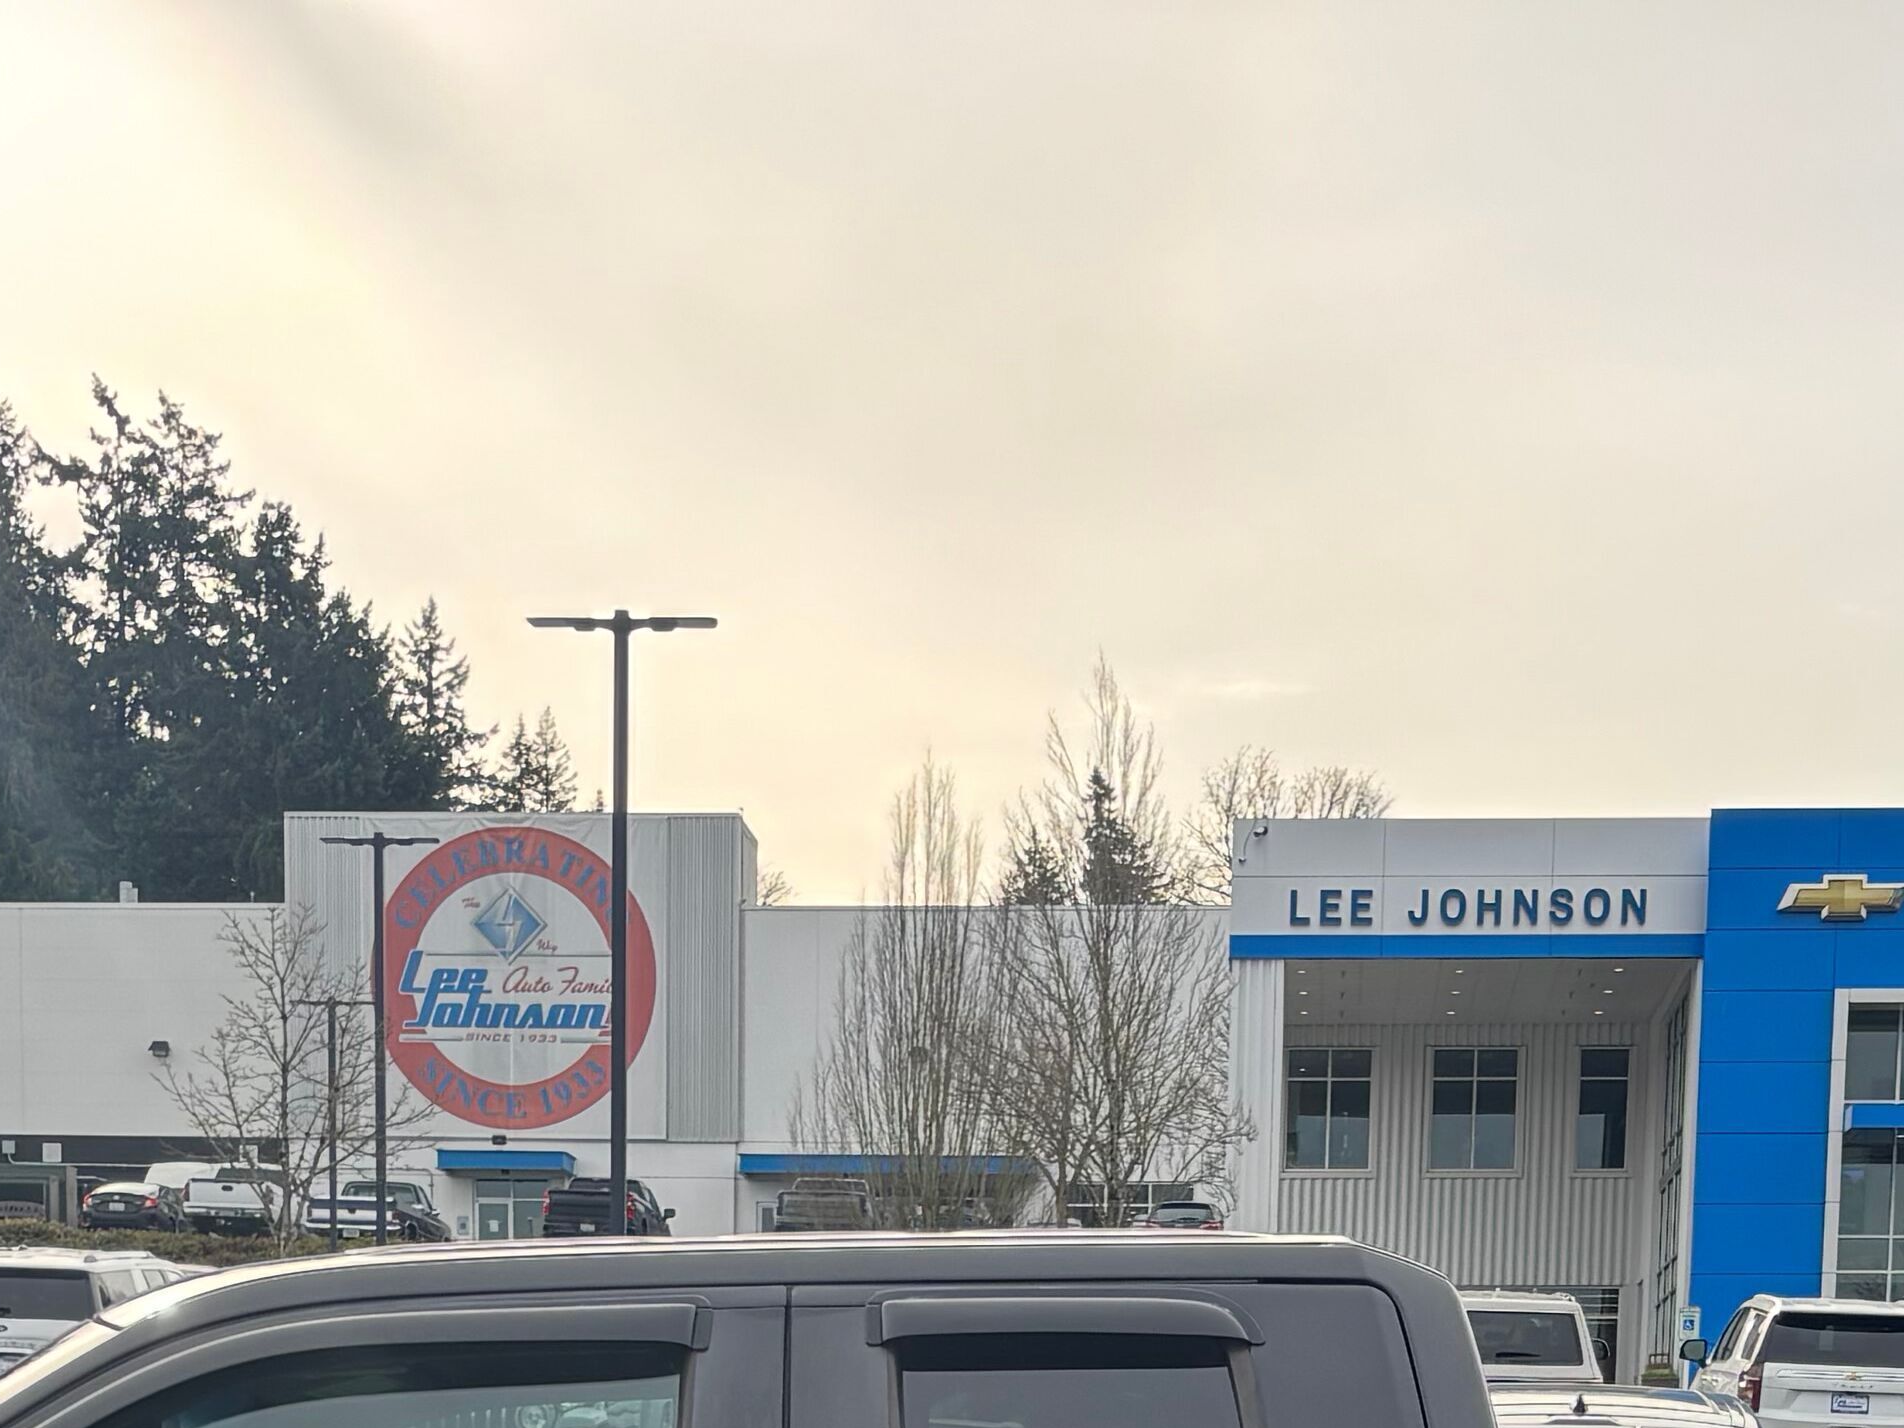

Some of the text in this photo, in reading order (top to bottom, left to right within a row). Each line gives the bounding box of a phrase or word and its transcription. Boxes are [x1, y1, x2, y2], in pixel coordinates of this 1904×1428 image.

[394, 836, 631, 929] CELEBRATIN
[1290, 888, 1648, 926] LEE JOHNSON
[400, 950, 613, 995] Lee Auto Fami
[403, 985, 609, 1029] Johnson
[465, 1032, 558, 1044] SINCE 1933
[417, 1056, 607, 1119] SINCE 1933
